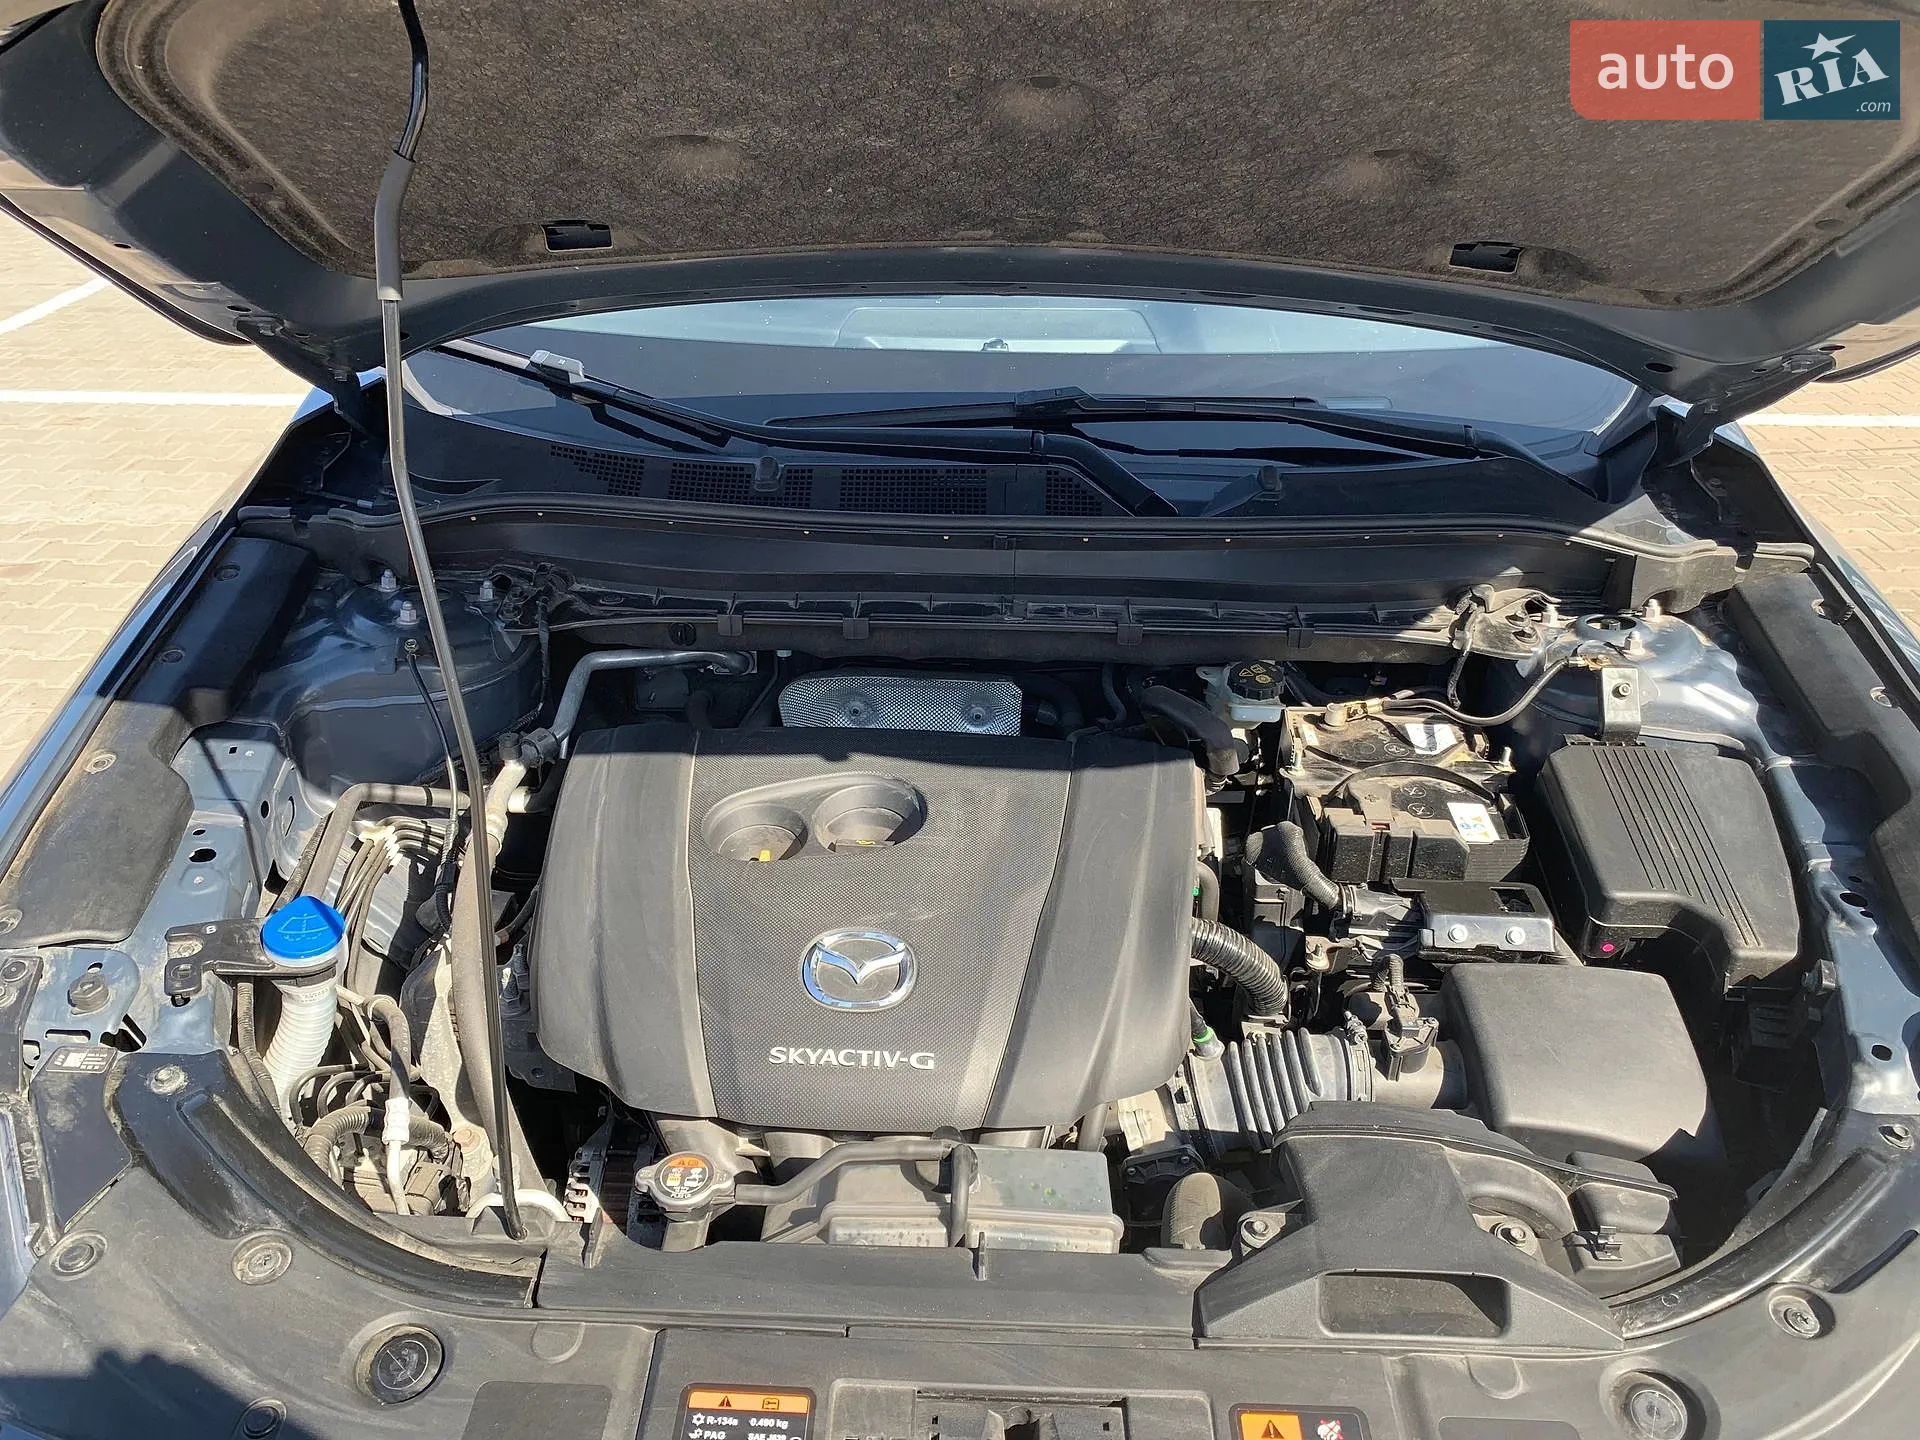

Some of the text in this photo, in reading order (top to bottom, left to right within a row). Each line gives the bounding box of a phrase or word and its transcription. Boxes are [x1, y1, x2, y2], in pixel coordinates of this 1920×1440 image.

[768, 1046, 935, 1070] SKYACTIV-G
[706, 1416, 739, 1426] R-134a
[775, 1418, 789, 1429] kg
[703, 1430, 726, 1440] PAG
